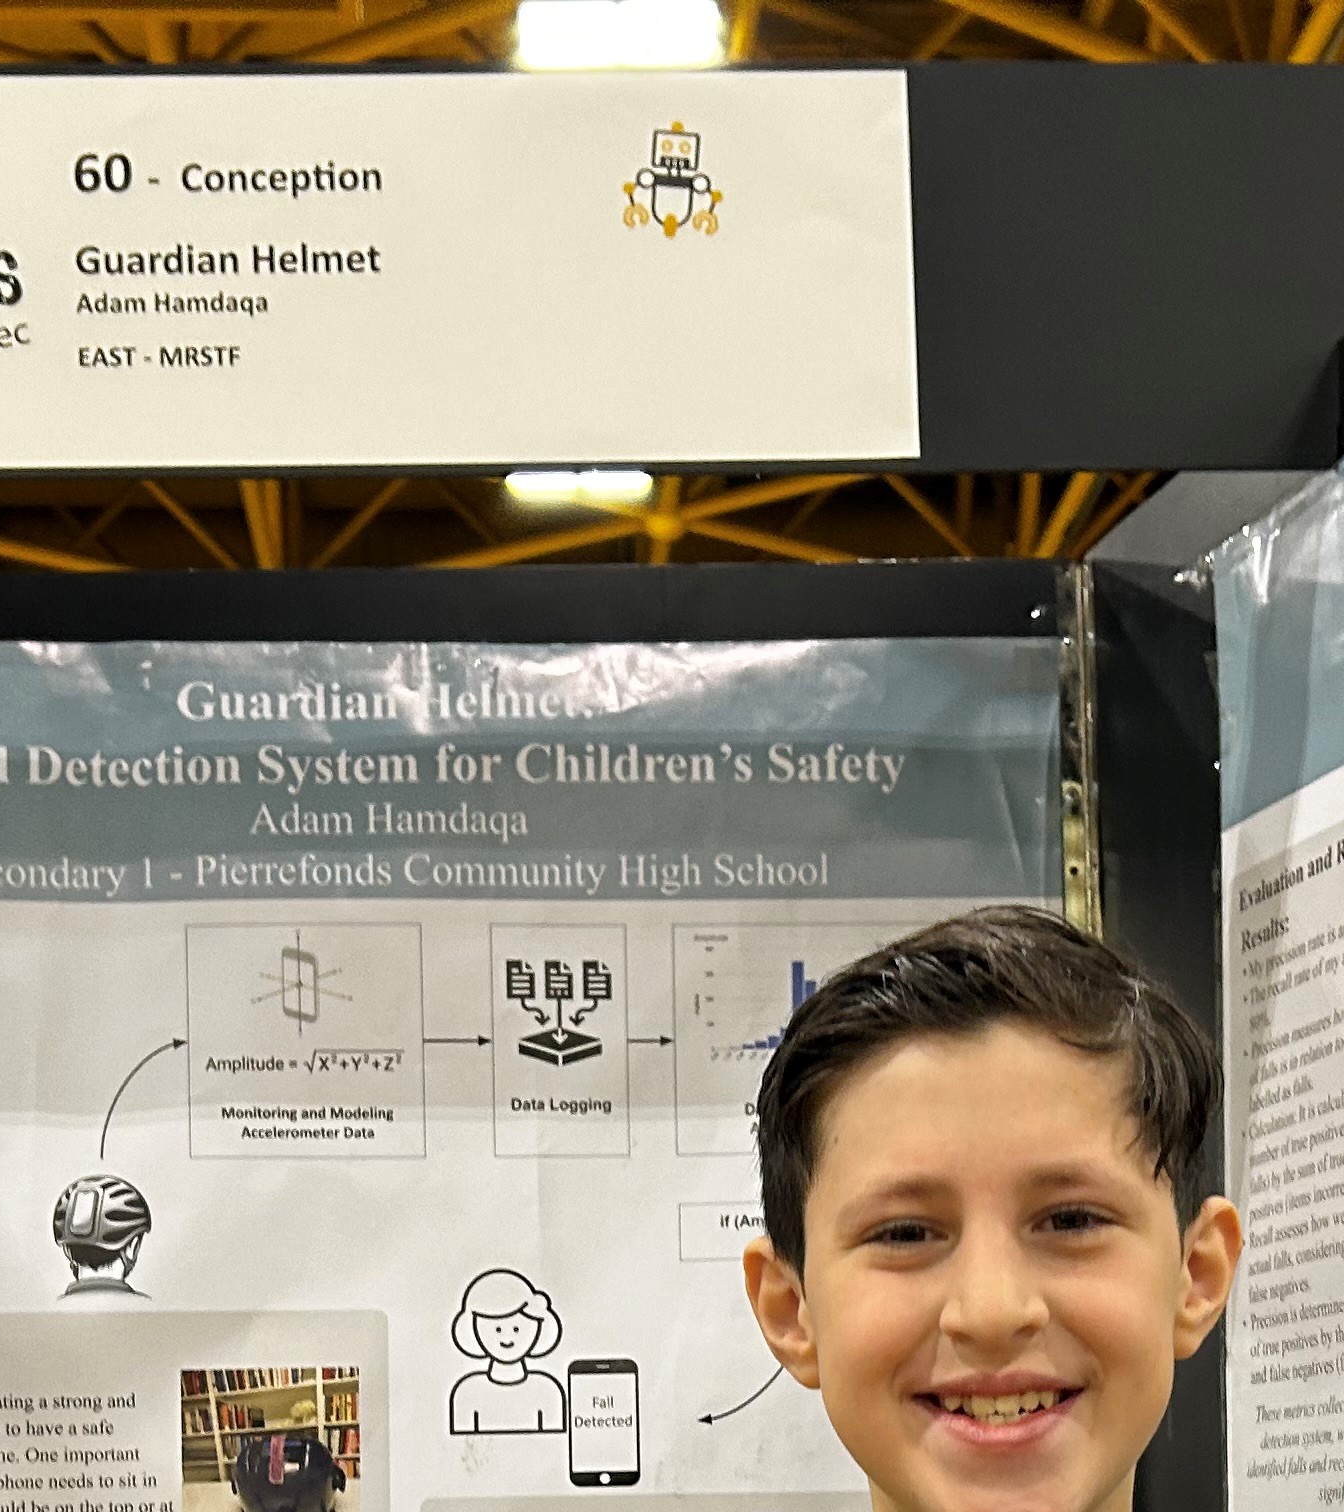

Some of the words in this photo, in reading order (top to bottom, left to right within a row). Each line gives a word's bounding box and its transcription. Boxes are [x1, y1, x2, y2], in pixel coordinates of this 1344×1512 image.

[75, 154, 132, 193] 60
[182, 161, 381, 199] Conception
[76, 243, 239, 276] Guardian
[253, 241, 381, 275] Helmet
[77, 292, 145, 314] Adam
[155, 291, 268, 319] Hamdaqa
[78, 346, 135, 368] EAST
[160, 346, 240, 368] MRSTF
[176, 680, 398, 723] Guardian
[27, 745, 241, 786] Detection
[258, 744, 418, 794] System
[436, 743, 502, 783] for
[516, 743, 753, 784] Children's
[769, 743, 906, 793] Safety
[250, 803, 354, 836] Adam
[367, 802, 529, 843] Hamdaqa
[196, 852, 391, 888] Pierrefonds
[402, 852, 607, 896] Community
[619, 852, 701, 895] High
[713, 852, 829, 887] School
[1238, 865, 1305, 912] Evaluation
[1307, 845, 1333, 879] and
[1240, 916, 1290, 954] Results:
[205, 1056, 285, 1075] Amplitude
[221, 1106, 298, 1123] Monitoring
[301, 1107, 326, 1121] and
[330, 1106, 394, 1122] Modeling
[510, 1097, 545, 1112] Data
[550, 1097, 612, 1115] Logging
[240, 1125, 340, 1140] Accelerometer
[343, 1125, 375, 1139] Data
[39, 1398, 48, 1410] a
[53, 1395, 103, 1413] strong
[108, 1392, 136, 1409] and
[593, 1395, 614, 1409] Fall
[575, 1415, 633, 1428] Detected
